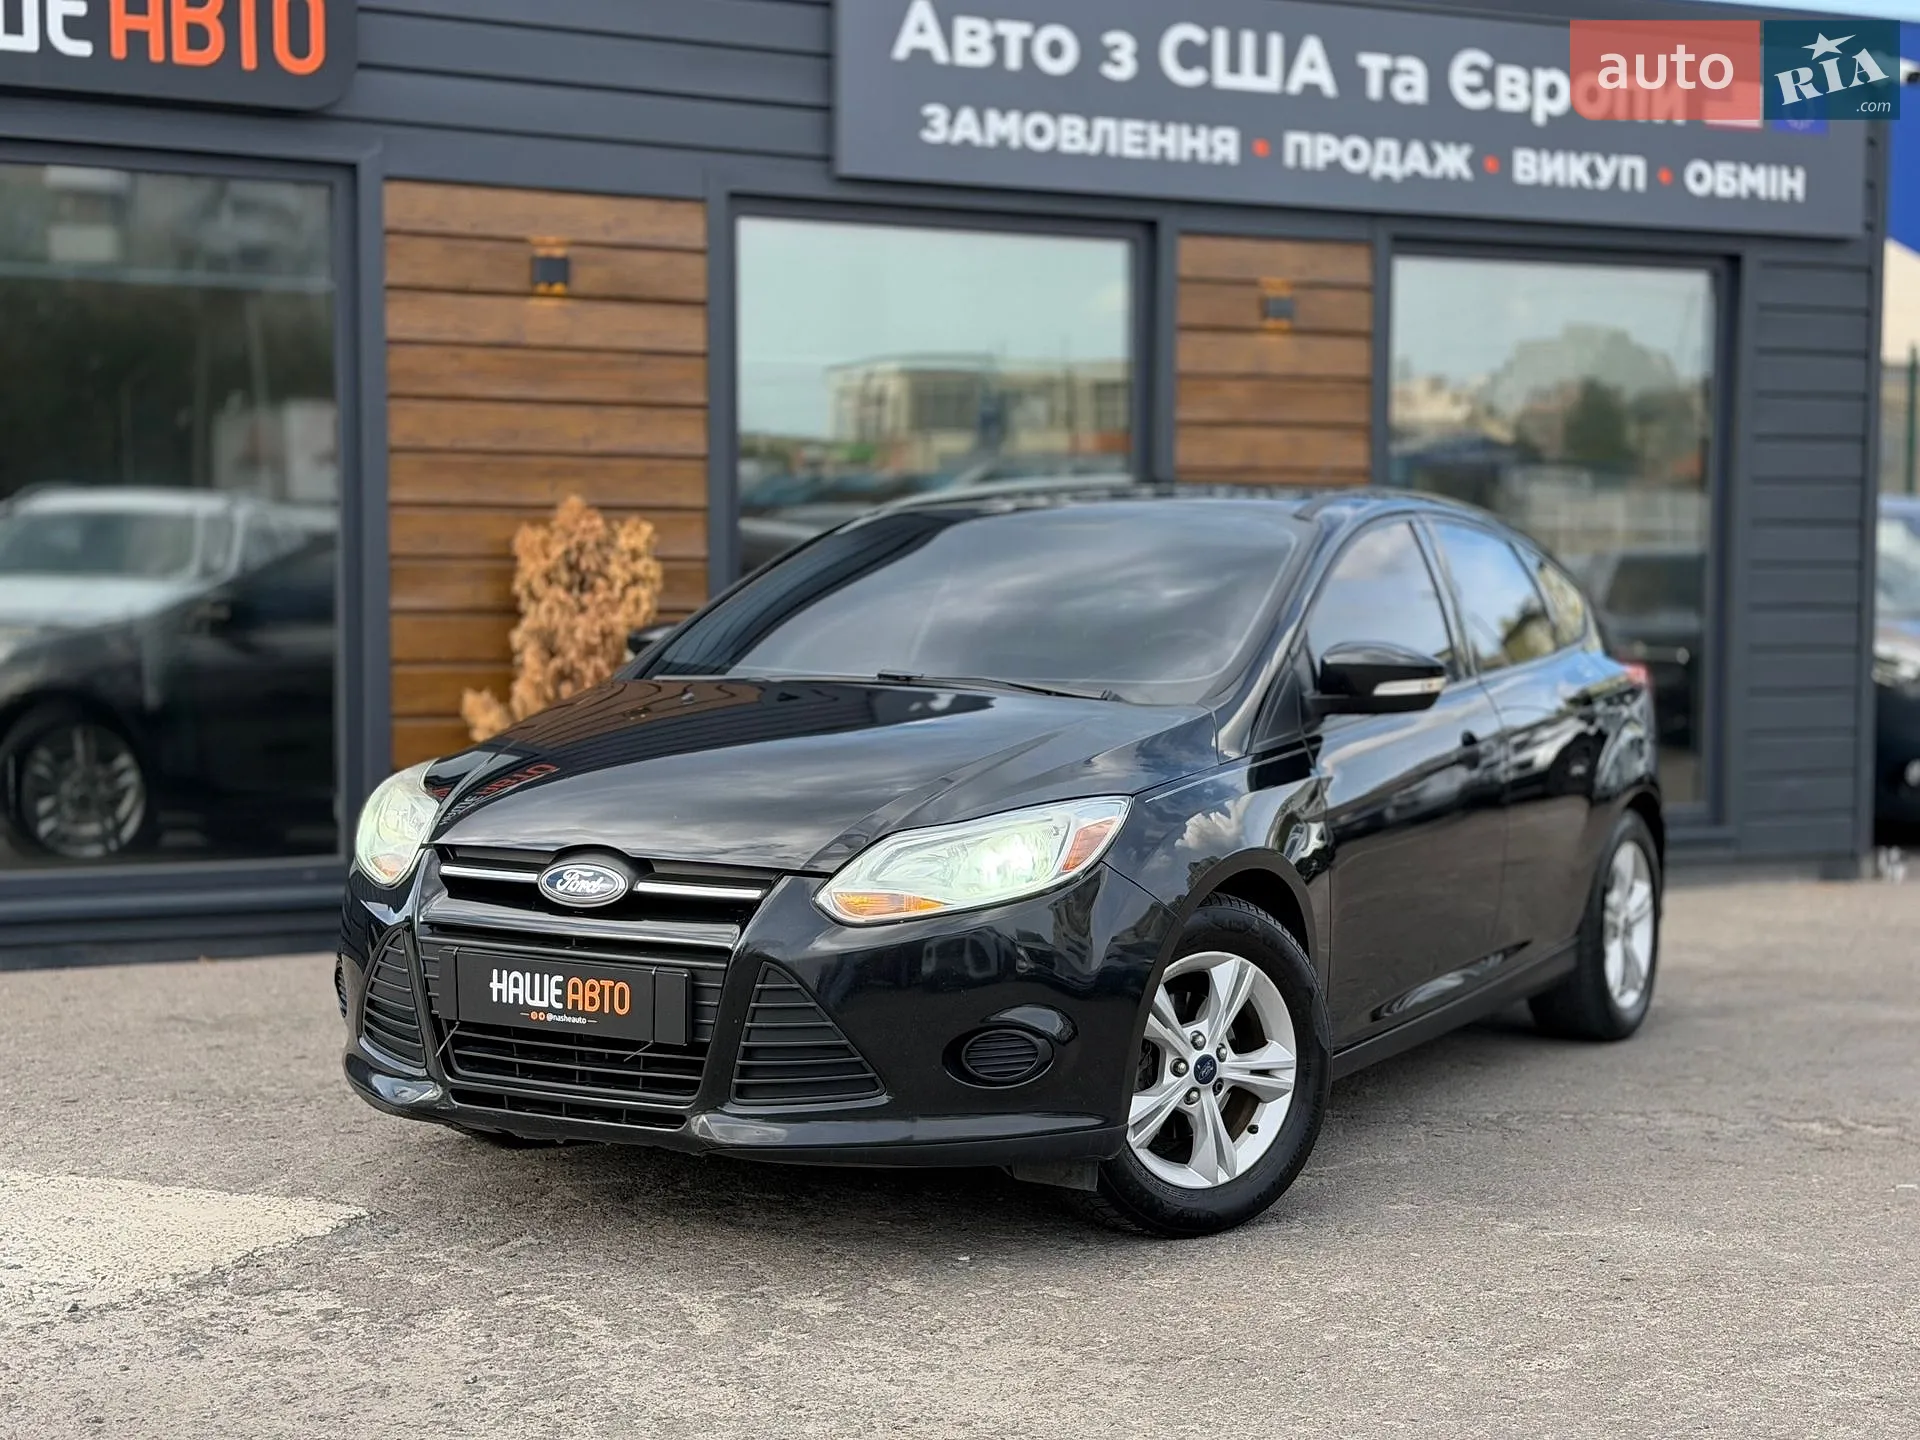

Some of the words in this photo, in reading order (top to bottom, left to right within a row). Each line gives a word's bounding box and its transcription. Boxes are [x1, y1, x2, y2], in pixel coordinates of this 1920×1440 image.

[891, 0, 1081, 76] Авто
[1158, 22, 1339, 98] США
[1357, 50, 1428, 105] та
[919, 103, 1240, 164] ЗАМОВЛЕННЯ
[1282, 132, 1474, 182] ПРОДАЖ
[1512, 148, 1647, 193] ВИКУП
[1684, 160, 1806, 202] ОБМІН
[556, 869, 604, 893] Ford
[489, 968, 564, 1010] НАШЕ
[567, 976, 631, 1016] АВТО
[546, 1012, 588, 1025] @nasheauto
